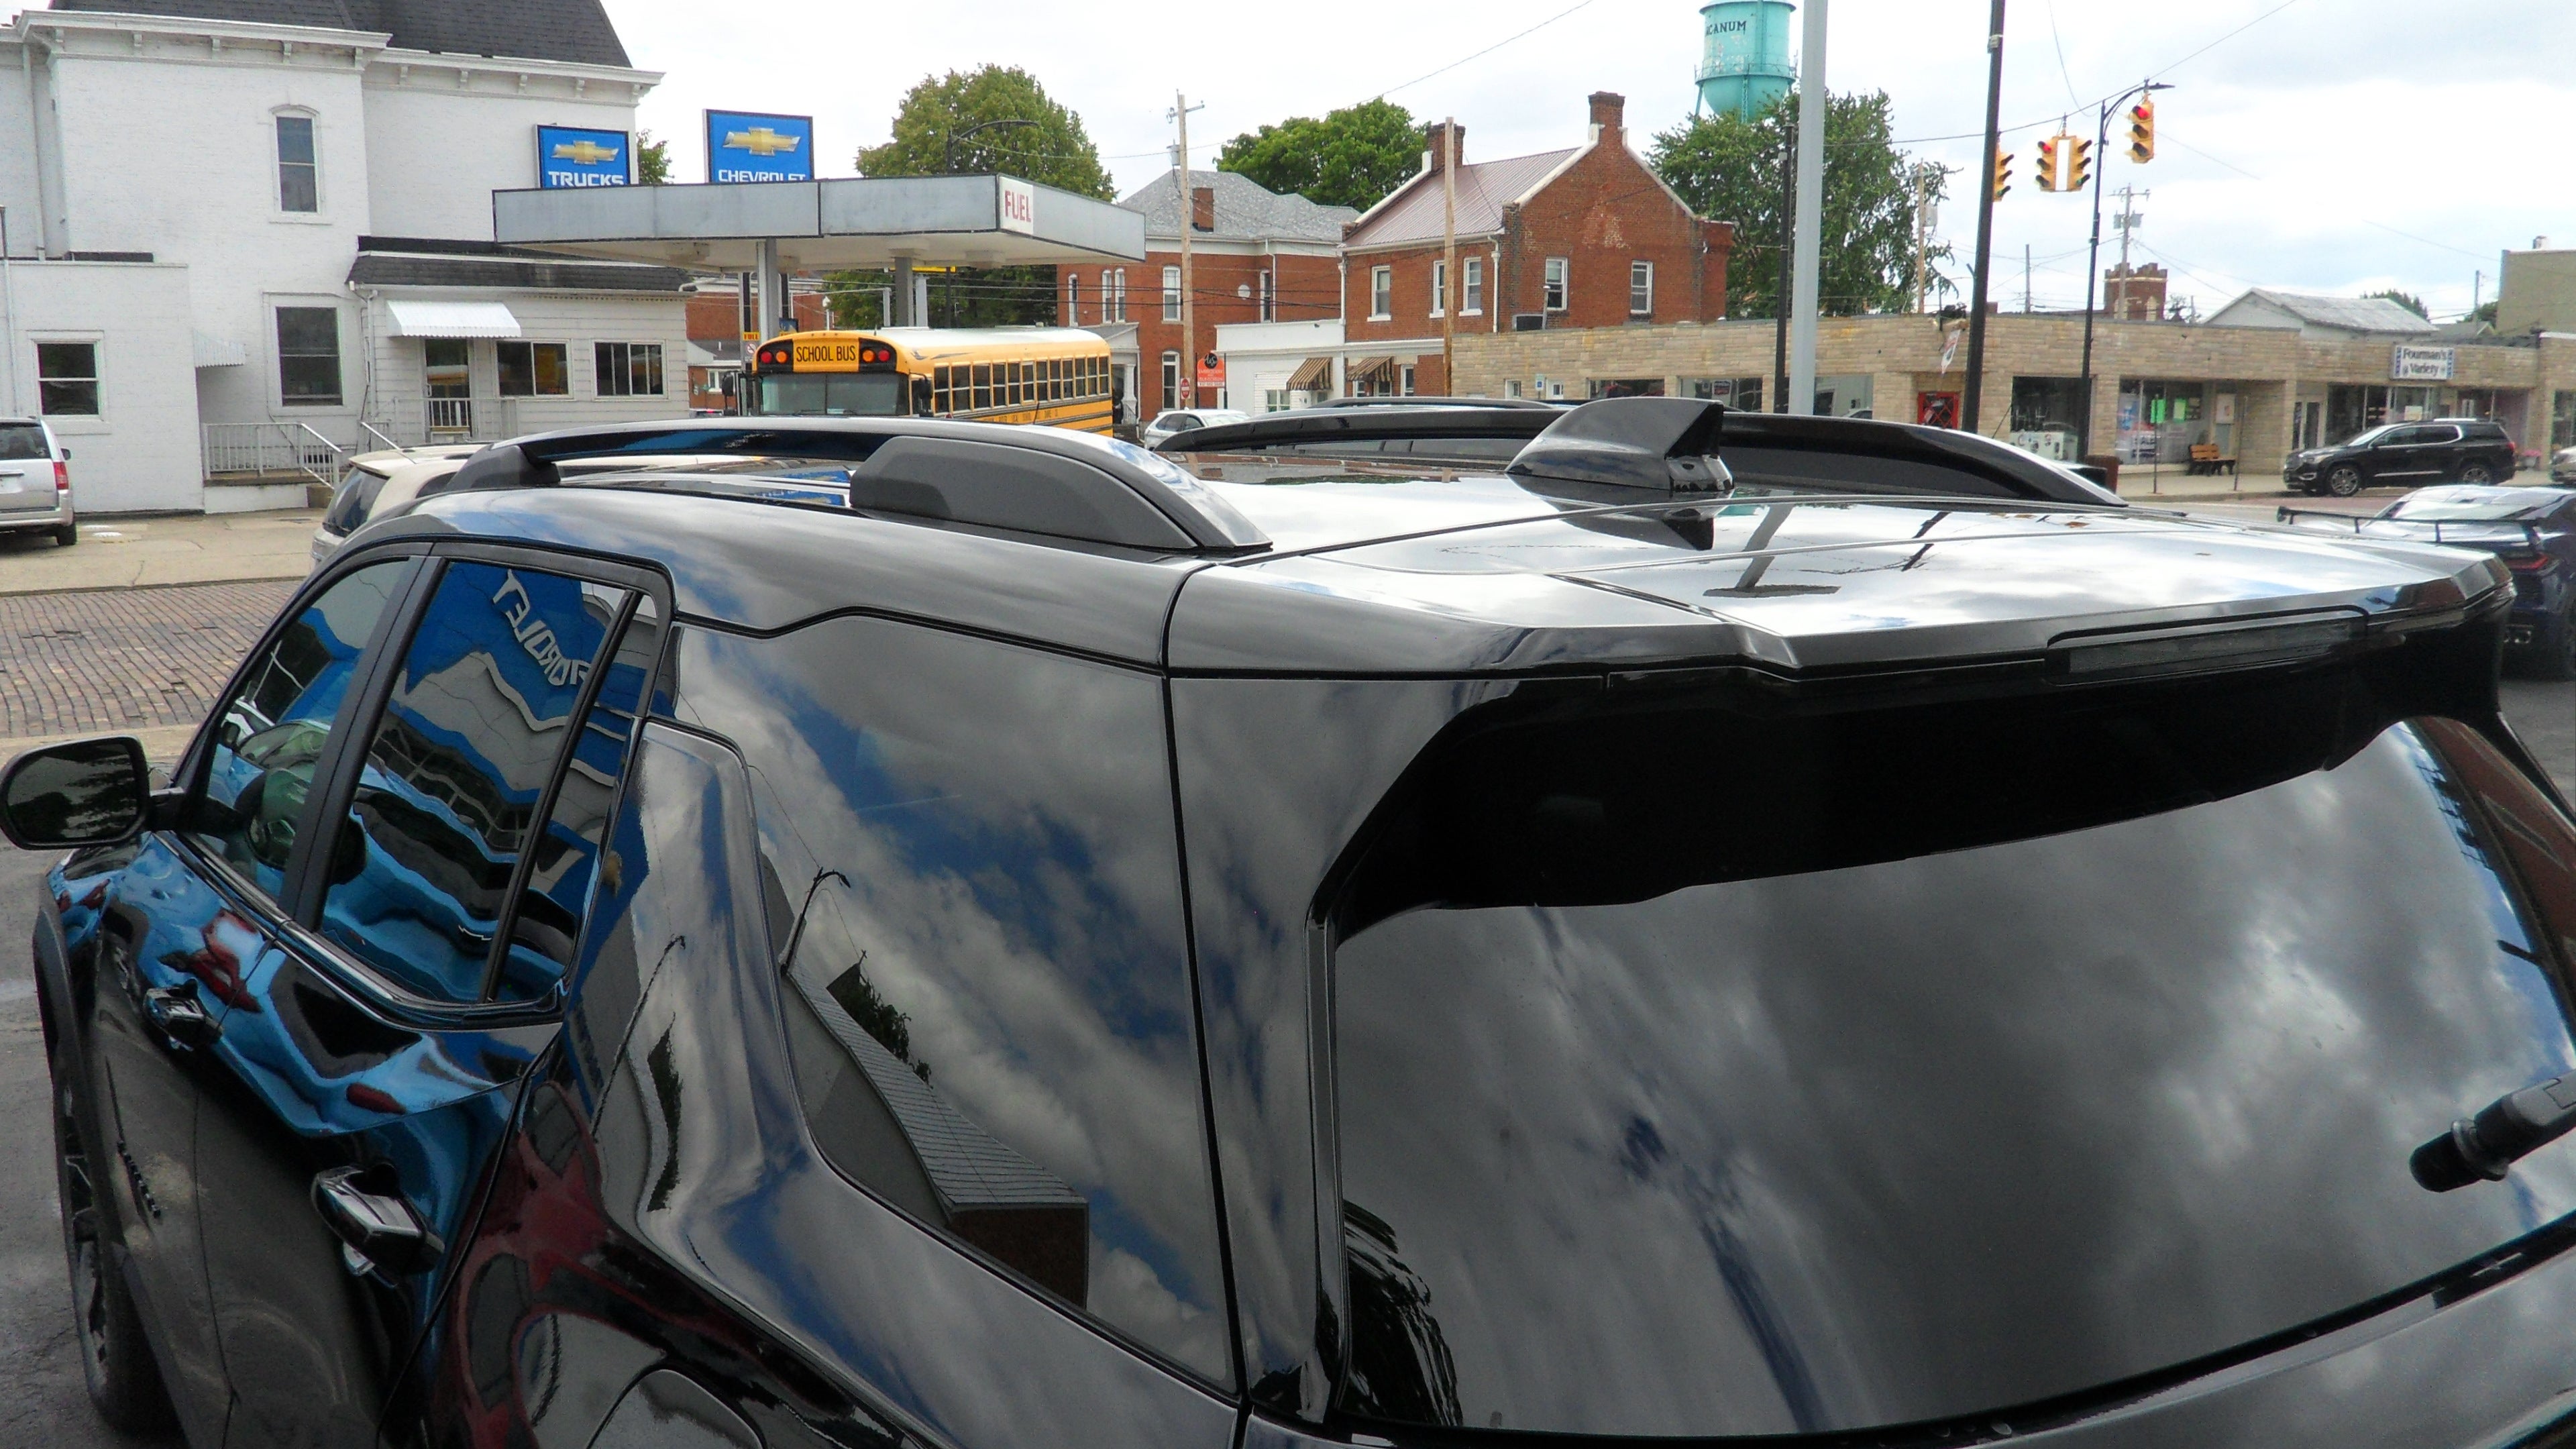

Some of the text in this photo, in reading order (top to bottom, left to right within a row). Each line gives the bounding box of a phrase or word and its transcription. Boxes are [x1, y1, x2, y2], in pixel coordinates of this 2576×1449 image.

[548, 171, 624, 187] TRUCKS
[1005, 190, 1032, 223] FUEL
[796, 345, 856, 362] SCHOOL BUS
[2409, 362, 2439, 377] Variety
